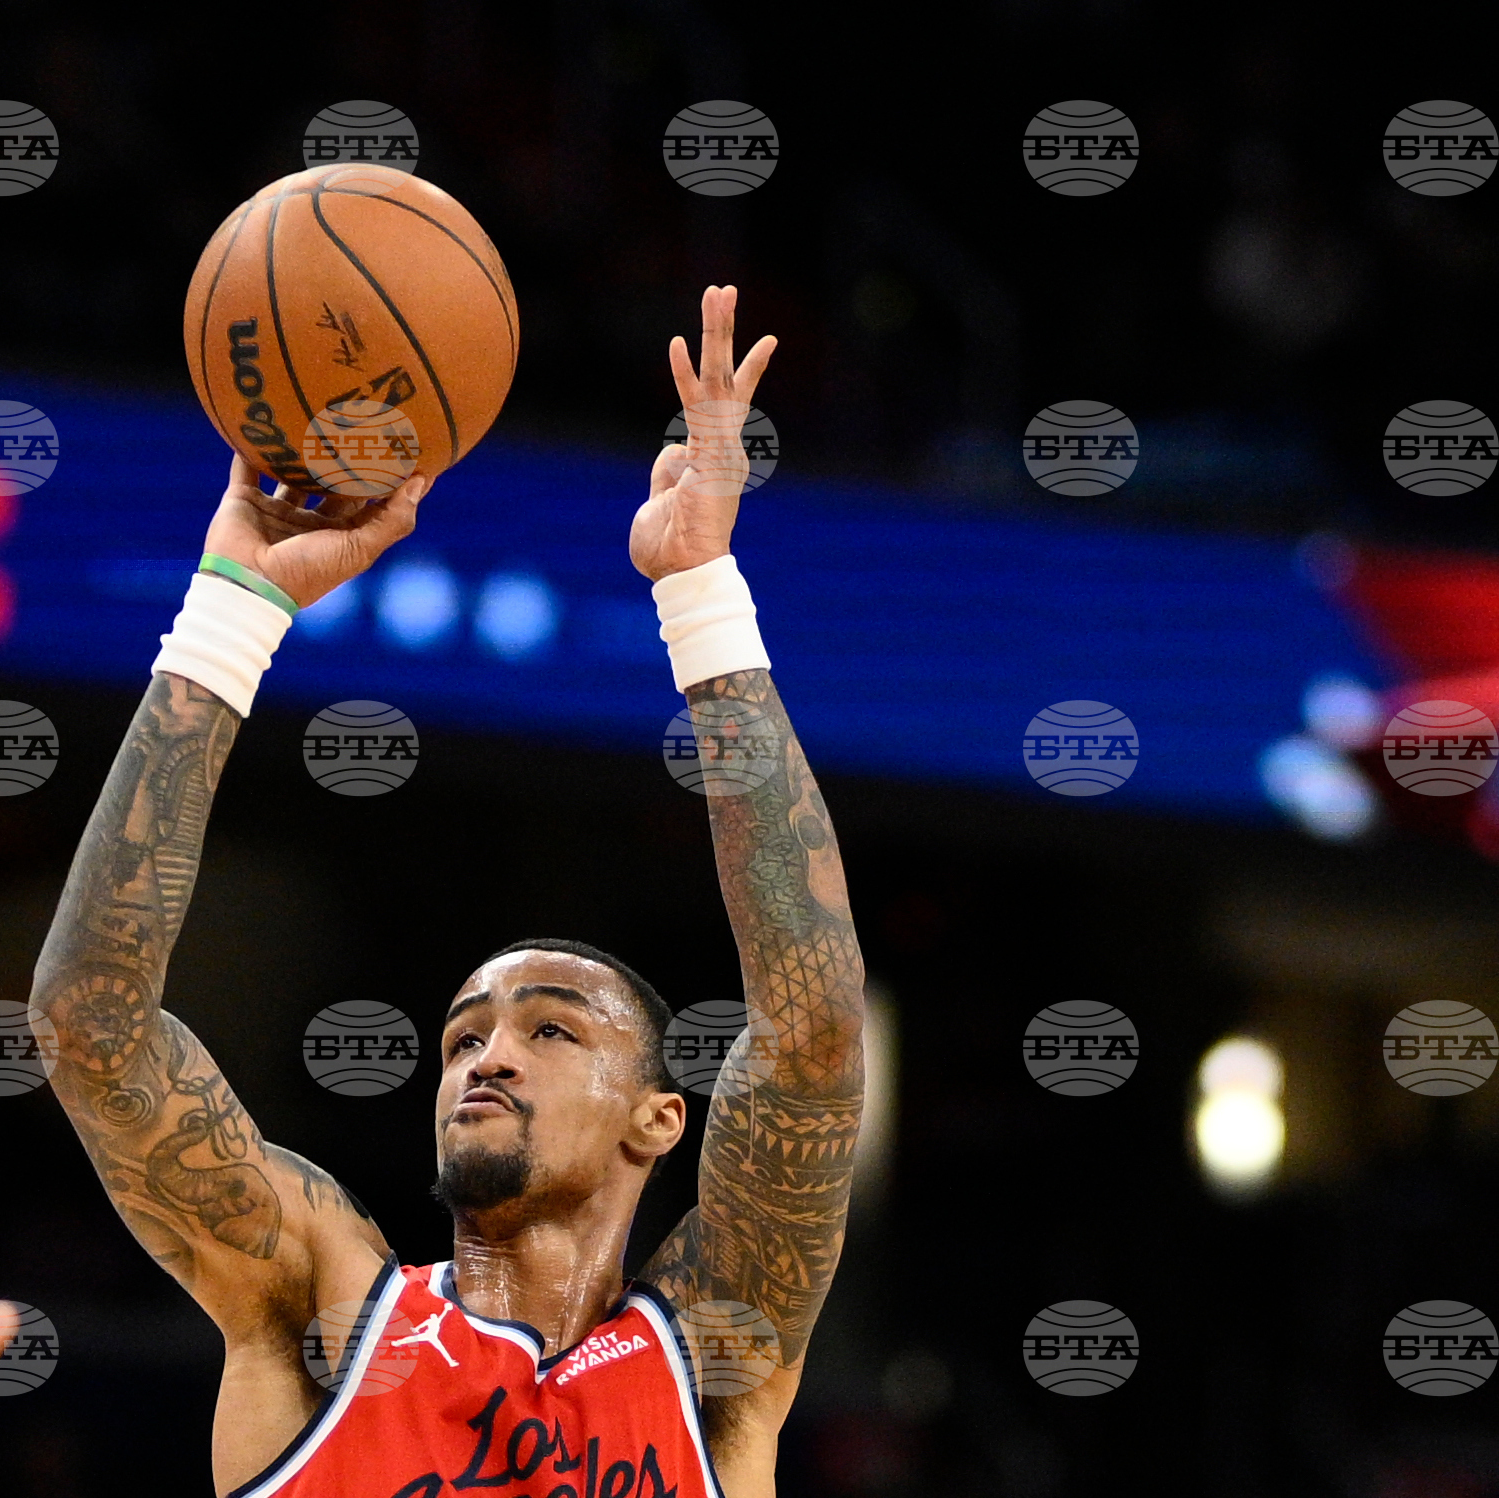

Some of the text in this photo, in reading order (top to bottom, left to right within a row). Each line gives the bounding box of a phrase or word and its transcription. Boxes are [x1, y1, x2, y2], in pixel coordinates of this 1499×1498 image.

[556, 1334, 649, 1386] RWANDA
[568, 1331, 619, 1361] VISIT
[451, 1385, 580, 1489] Los
